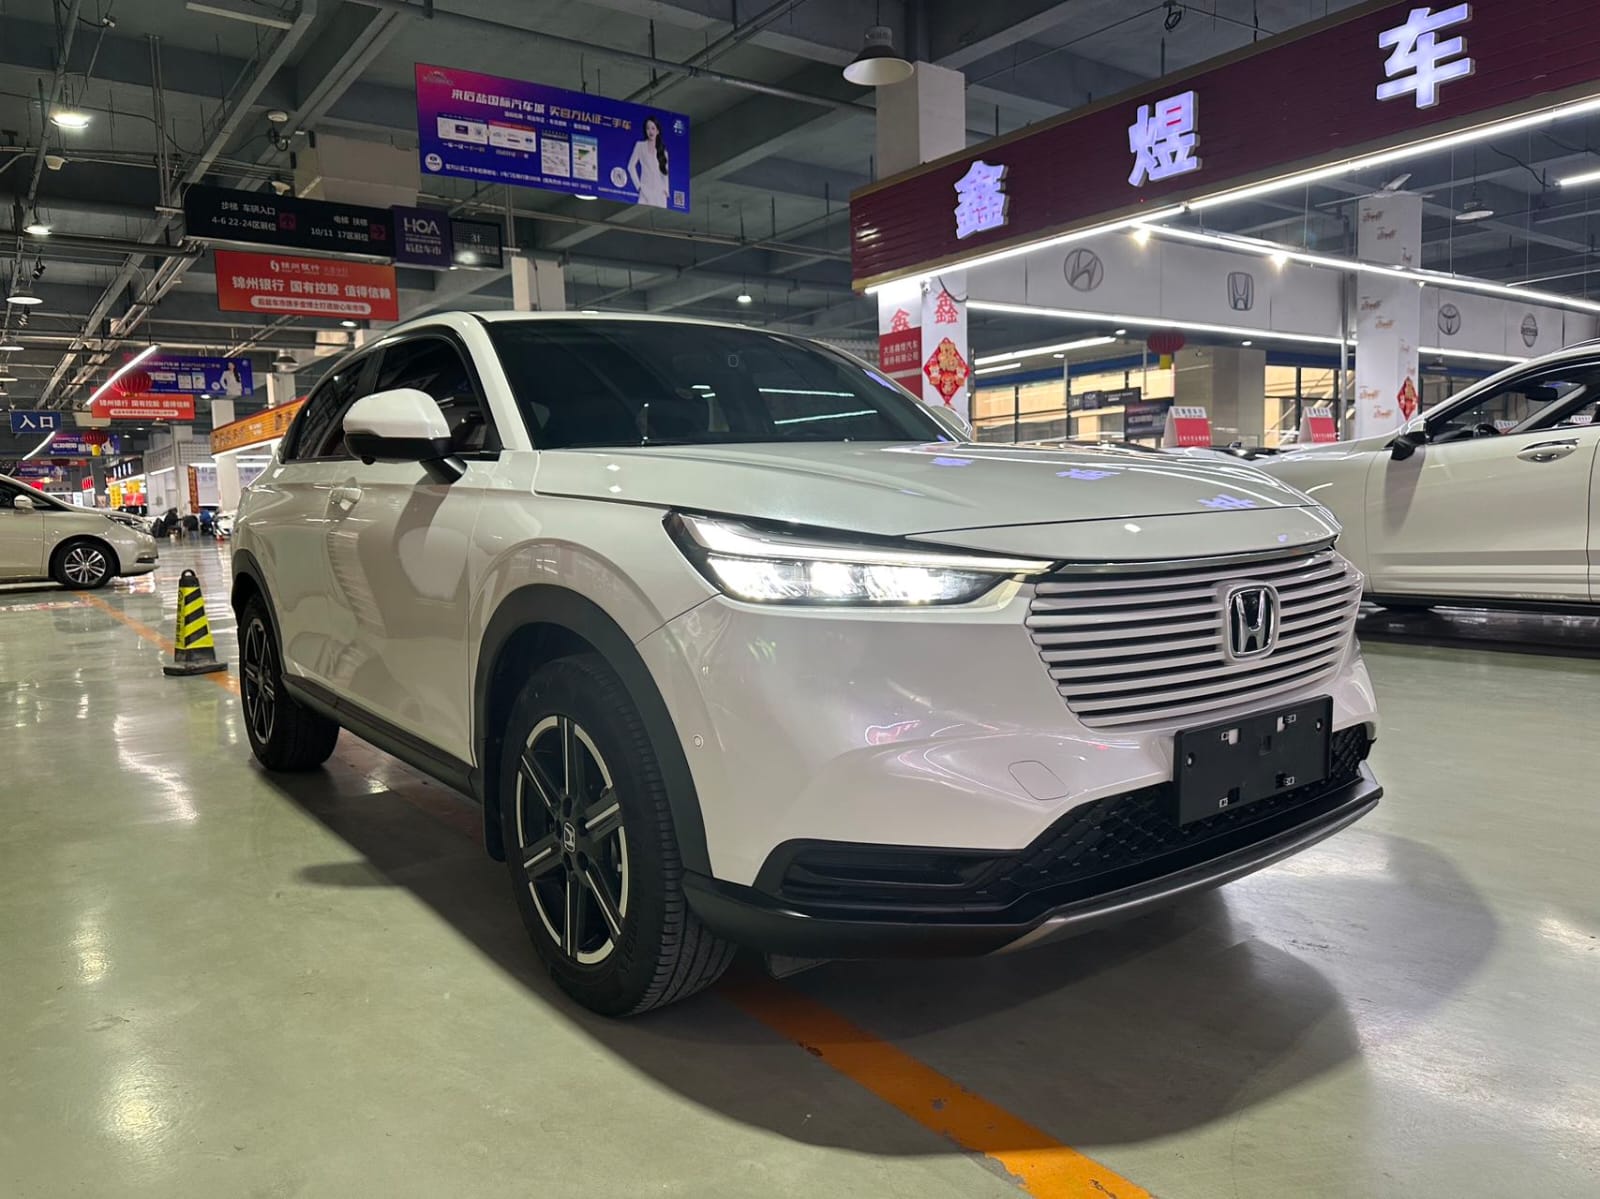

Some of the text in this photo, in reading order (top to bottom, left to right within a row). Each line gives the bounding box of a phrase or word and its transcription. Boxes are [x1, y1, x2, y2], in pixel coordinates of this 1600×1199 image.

[403, 217, 440, 235] HOA
[231, 275, 392, 300] 锦州银行 国有控股 值得信赖
[934, 289, 959, 324] 鑫
[19, 415, 54, 429] 入口
